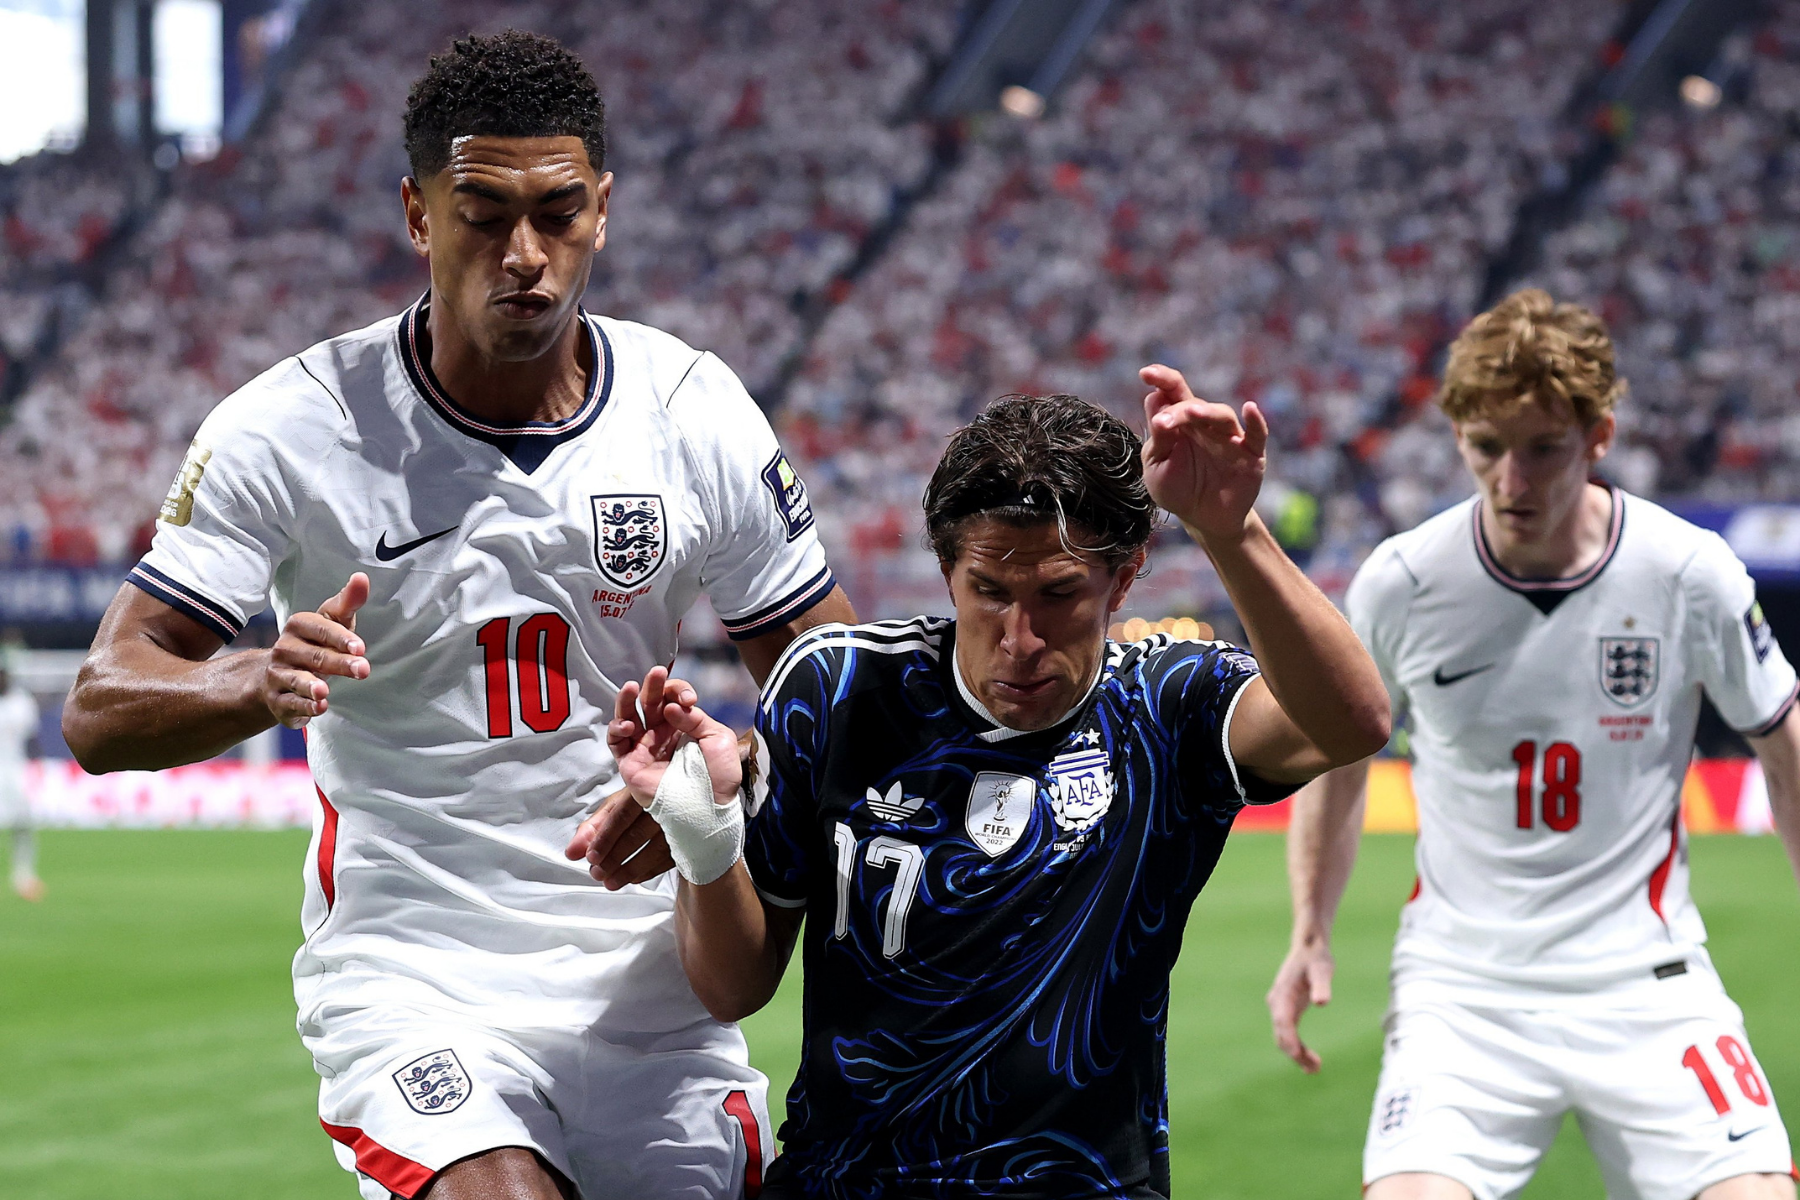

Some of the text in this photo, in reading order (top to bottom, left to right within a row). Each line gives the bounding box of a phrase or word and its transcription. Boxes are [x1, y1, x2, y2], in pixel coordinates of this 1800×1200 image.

[160, 505, 177, 517] 026
[476, 612, 571, 739] 10
[1066, 771, 1103, 806] AFA
[1512, 740, 1582, 832] 18
[983, 823, 1011, 837] FIFA
[986, 838, 1004, 846] 2022
[834, 821, 926, 960] 17
[1682, 1034, 1769, 1117] 18
